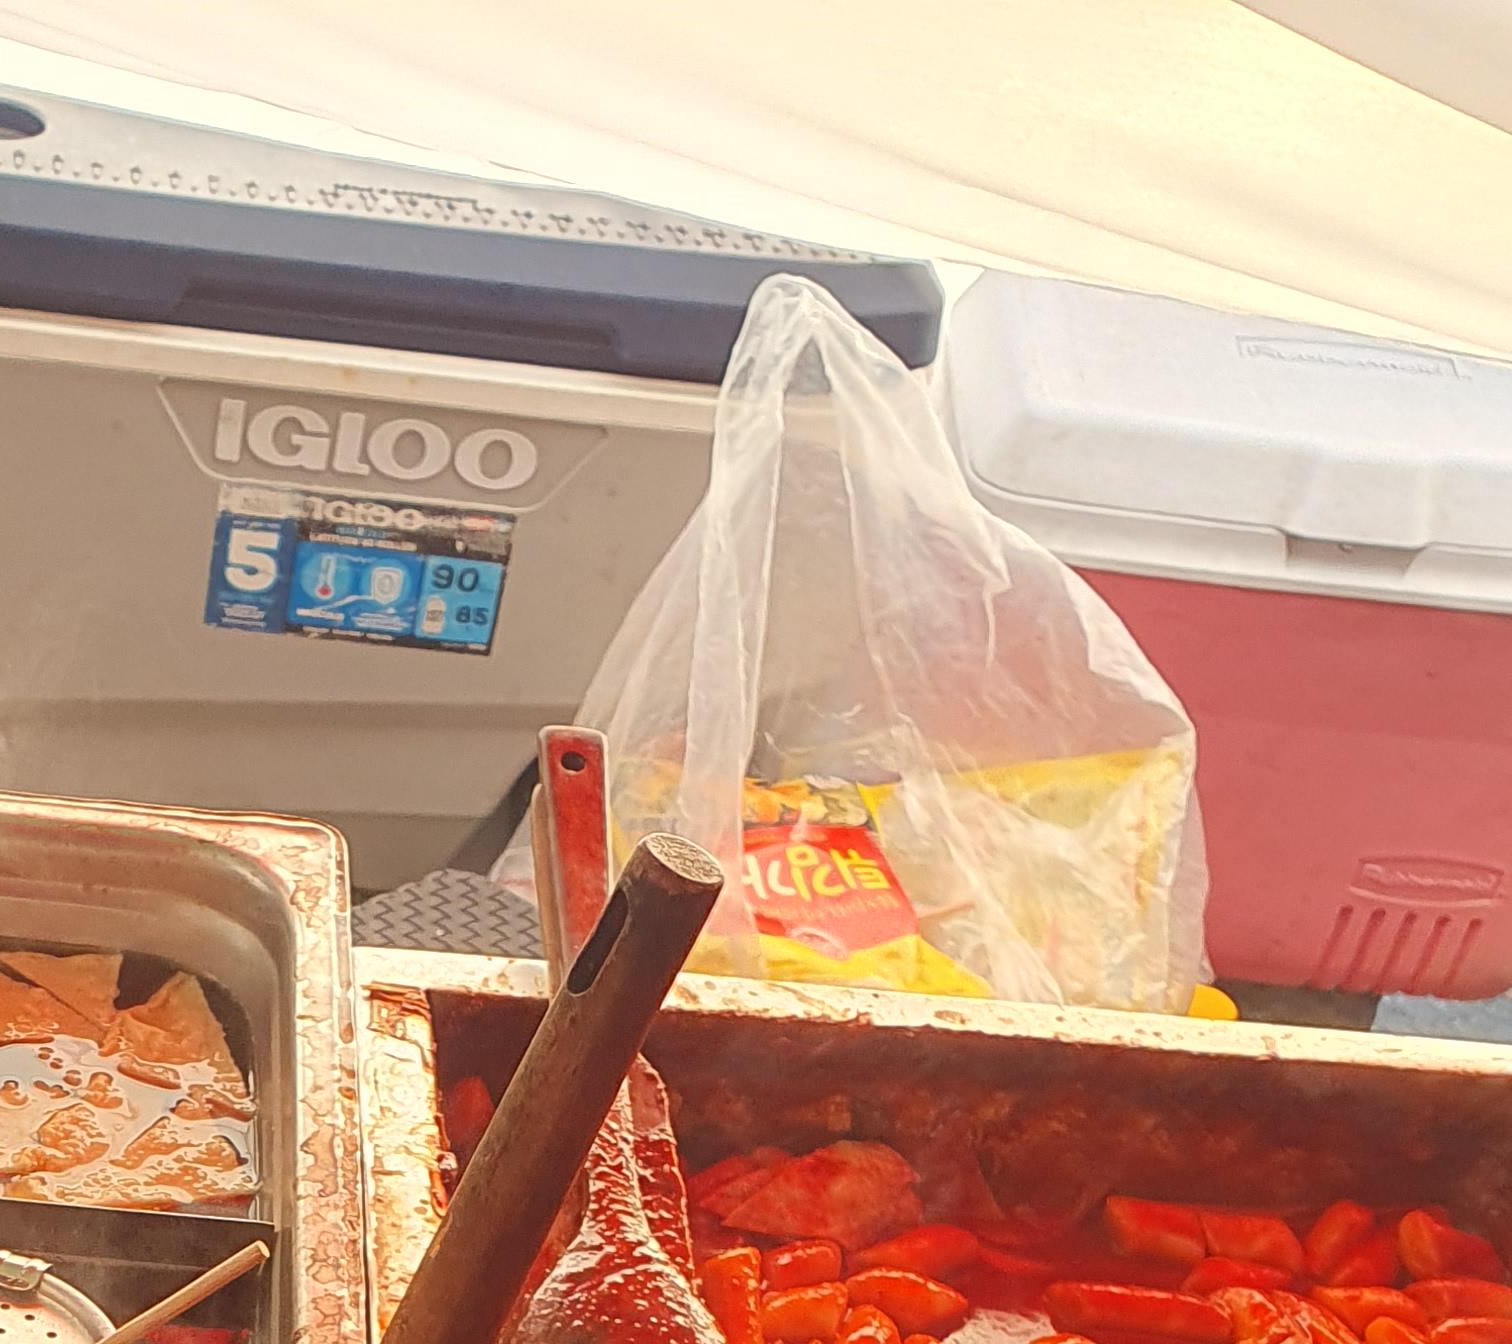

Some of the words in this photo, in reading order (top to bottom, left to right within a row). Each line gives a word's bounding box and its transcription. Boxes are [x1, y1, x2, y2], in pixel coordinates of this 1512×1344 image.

[215, 398, 538, 490] IGLOO
[224, 529, 280, 591] 5
[431, 563, 481, 593] 90
